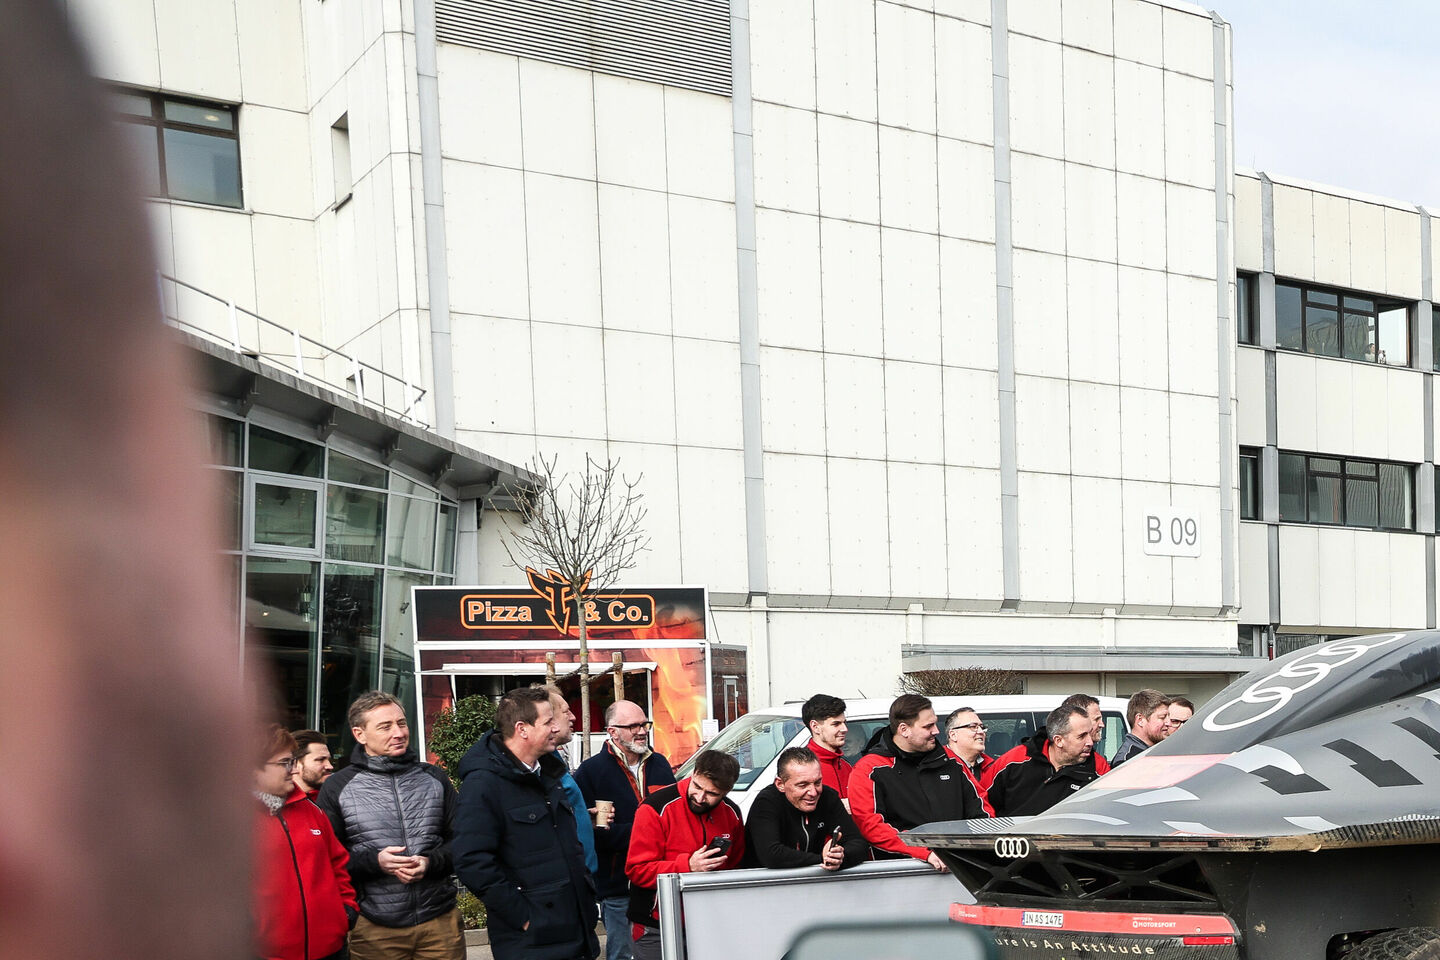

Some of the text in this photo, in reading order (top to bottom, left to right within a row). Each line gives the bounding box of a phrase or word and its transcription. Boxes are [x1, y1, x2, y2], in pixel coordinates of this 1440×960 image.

[1147, 515, 1197, 546] B 09
[467, 601, 649, 622] Pizza & Co.
[1026, 913, 1034, 923] IN
[1034, 913, 1044, 924] AS
[1022, 938, 1038, 948] Is
[1043, 939, 1065, 950] An
[1071, 941, 1155, 955] Attitude
